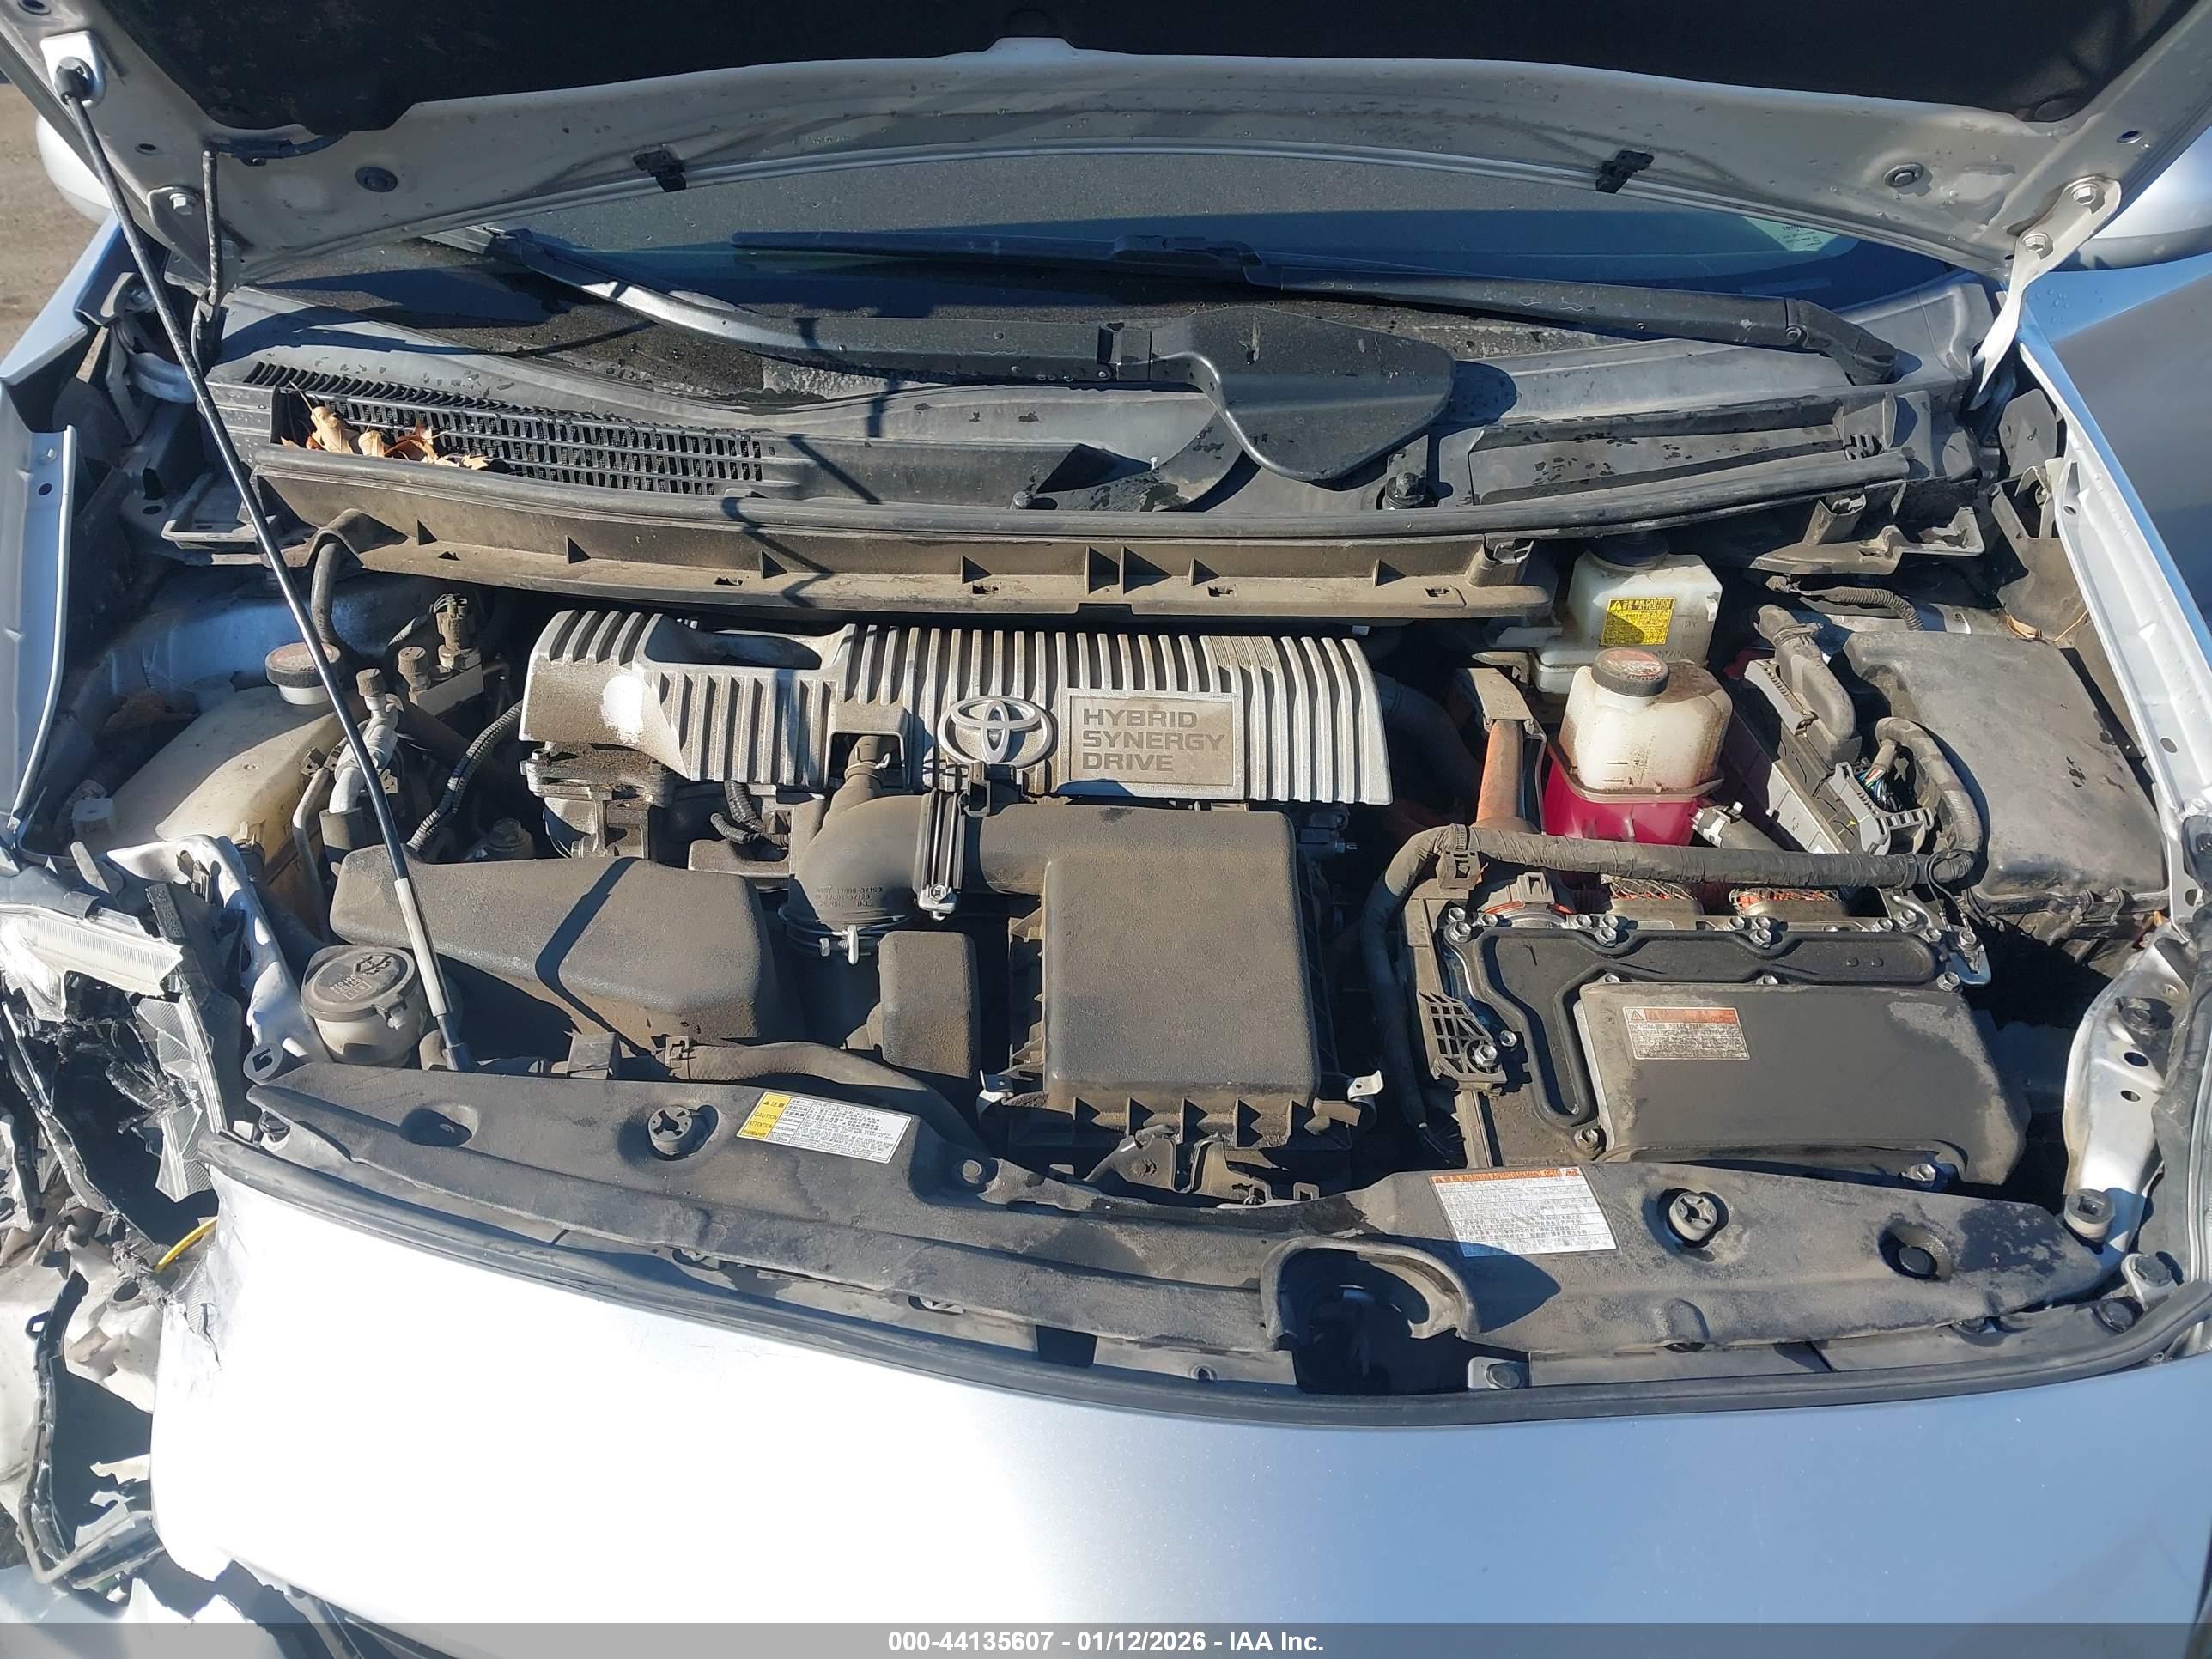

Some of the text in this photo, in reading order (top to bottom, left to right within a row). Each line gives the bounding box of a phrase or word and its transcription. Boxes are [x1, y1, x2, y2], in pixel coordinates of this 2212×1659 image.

[1083, 708, 1197, 728] HYBRID
[1082, 730, 1225, 751] SYNERGY
[1082, 752, 1174, 772] DRIVE
[754, 1111, 779, 1120] CAUTION
